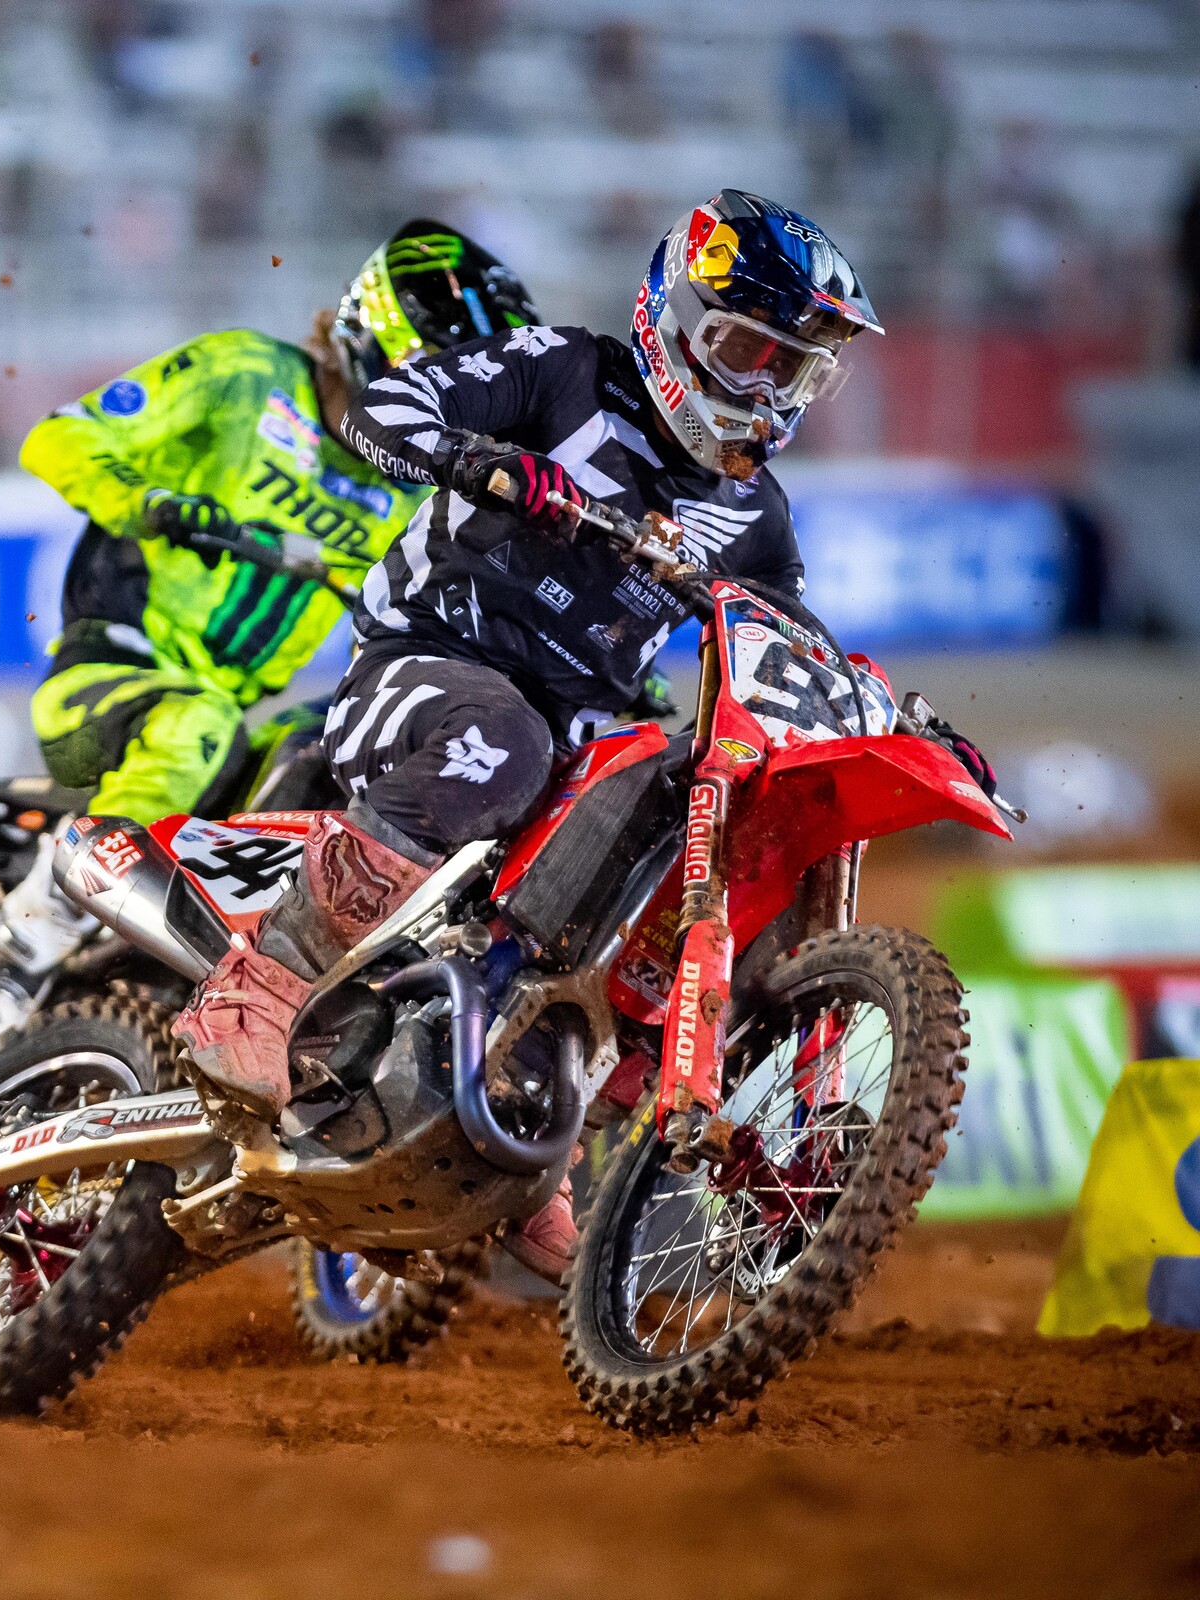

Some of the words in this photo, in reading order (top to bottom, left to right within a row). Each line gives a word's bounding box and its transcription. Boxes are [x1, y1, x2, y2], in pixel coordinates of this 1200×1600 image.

[250, 459, 369, 549] THOR
[628, 563, 676, 606] ELEVATED
[546, 640, 594, 676] DUNLOP
[236, 812, 317, 823] HOND
[684, 784, 718, 887] SHOWA
[675, 960, 701, 1077] DUNLOP
[11, 1124, 57, 1154] DID
